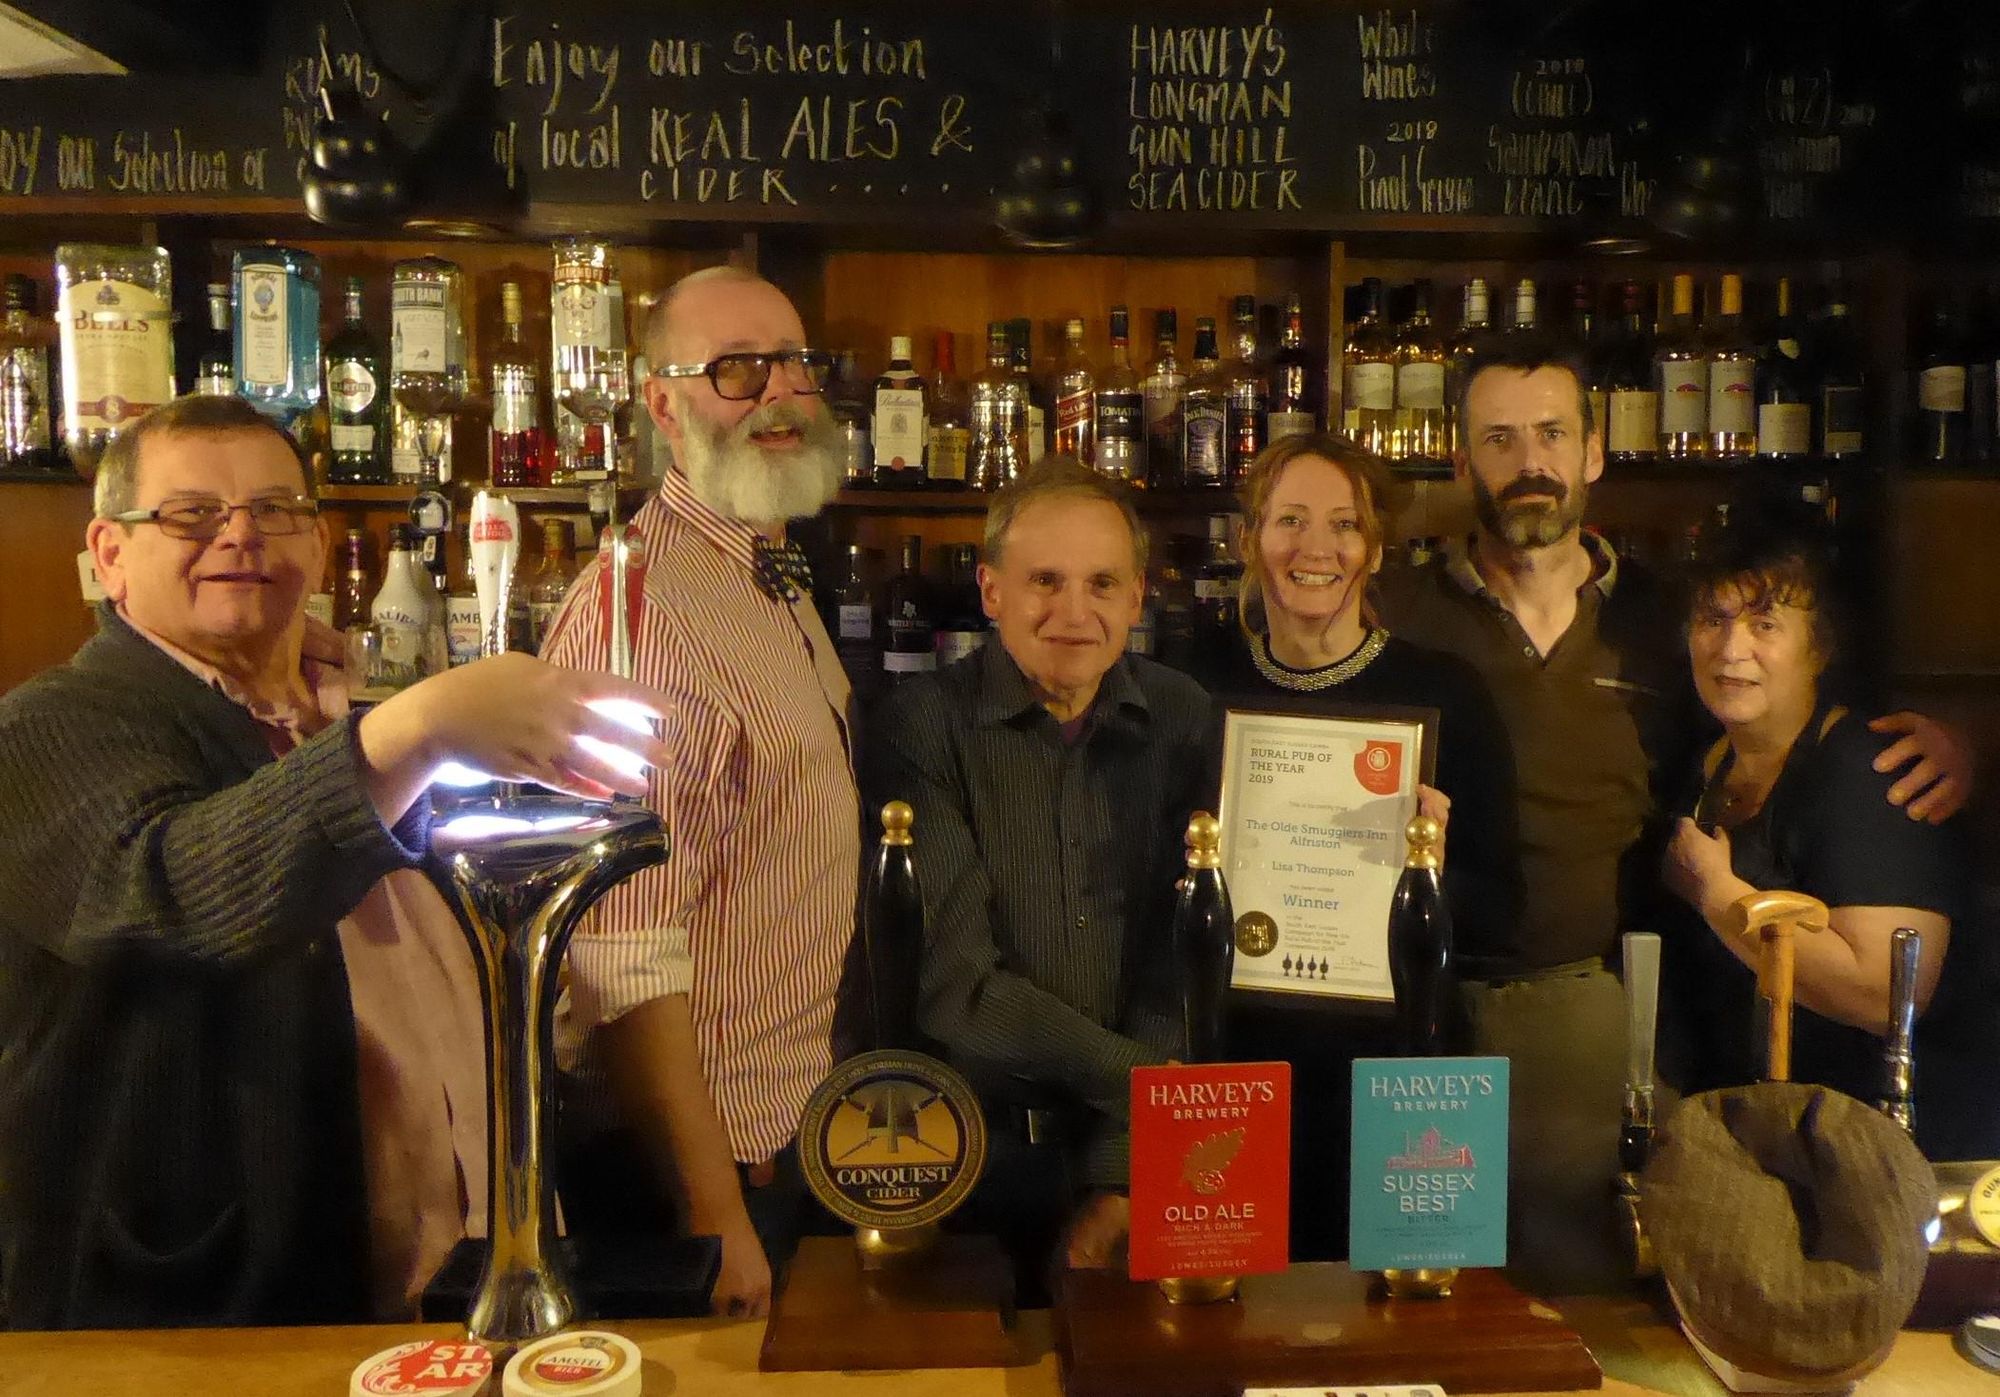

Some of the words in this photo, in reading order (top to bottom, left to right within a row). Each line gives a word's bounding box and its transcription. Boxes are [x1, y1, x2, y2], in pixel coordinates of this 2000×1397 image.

[492, 16, 621, 116] Enjoy
[648, 38, 709, 78] our
[723, 17, 926, 79] Selection
[540, 104, 621, 170] local
[650, 96, 761, 168] REAL
[780, 95, 905, 162] ALES
[930, 93, 973, 157] &
[1386, 120, 1439, 144] 2018
[1129, 123, 1194, 171] GUN
[1208, 124, 1297, 168] HILL
[640, 166, 798, 206] CIDER
[450, 613, 481, 624] AMB
[1250, 747, 1291, 761] RURAL
[1292, 751, 1315, 762] PUB
[1317, 753, 1333, 763] OF
[1250, 761, 1272, 772] THE
[1276, 762, 1305, 774] YEAR
[1248, 773, 1274, 784] 2019
[1246, 819, 1268, 831] The
[1270, 821, 1299, 833] Olde
[1301, 823, 1364, 840] Smugglers
[1367, 829, 1388, 841] Inn
[1290, 836, 1341, 849] Alfriston
[1295, 863, 1355, 878] Thompson
[1283, 893, 1340, 911] Winner
[1150, 1081, 1275, 1107] HARVEY'S
[1370, 1073, 1493, 1098] HARVEY'S
[1173, 1107, 1250, 1120] BREWERY
[1393, 1100, 1469, 1112] BREWERY
[836, 1166, 953, 1188] CONQUEST
[1382, 1174, 1476, 1193] SUSSEX
[866, 1187, 921, 1199] CIDER
[1165, 1205, 1208, 1222] OLD
[1214, 1202, 1256, 1219] ALE
[1399, 1194, 1460, 1213] BEST
